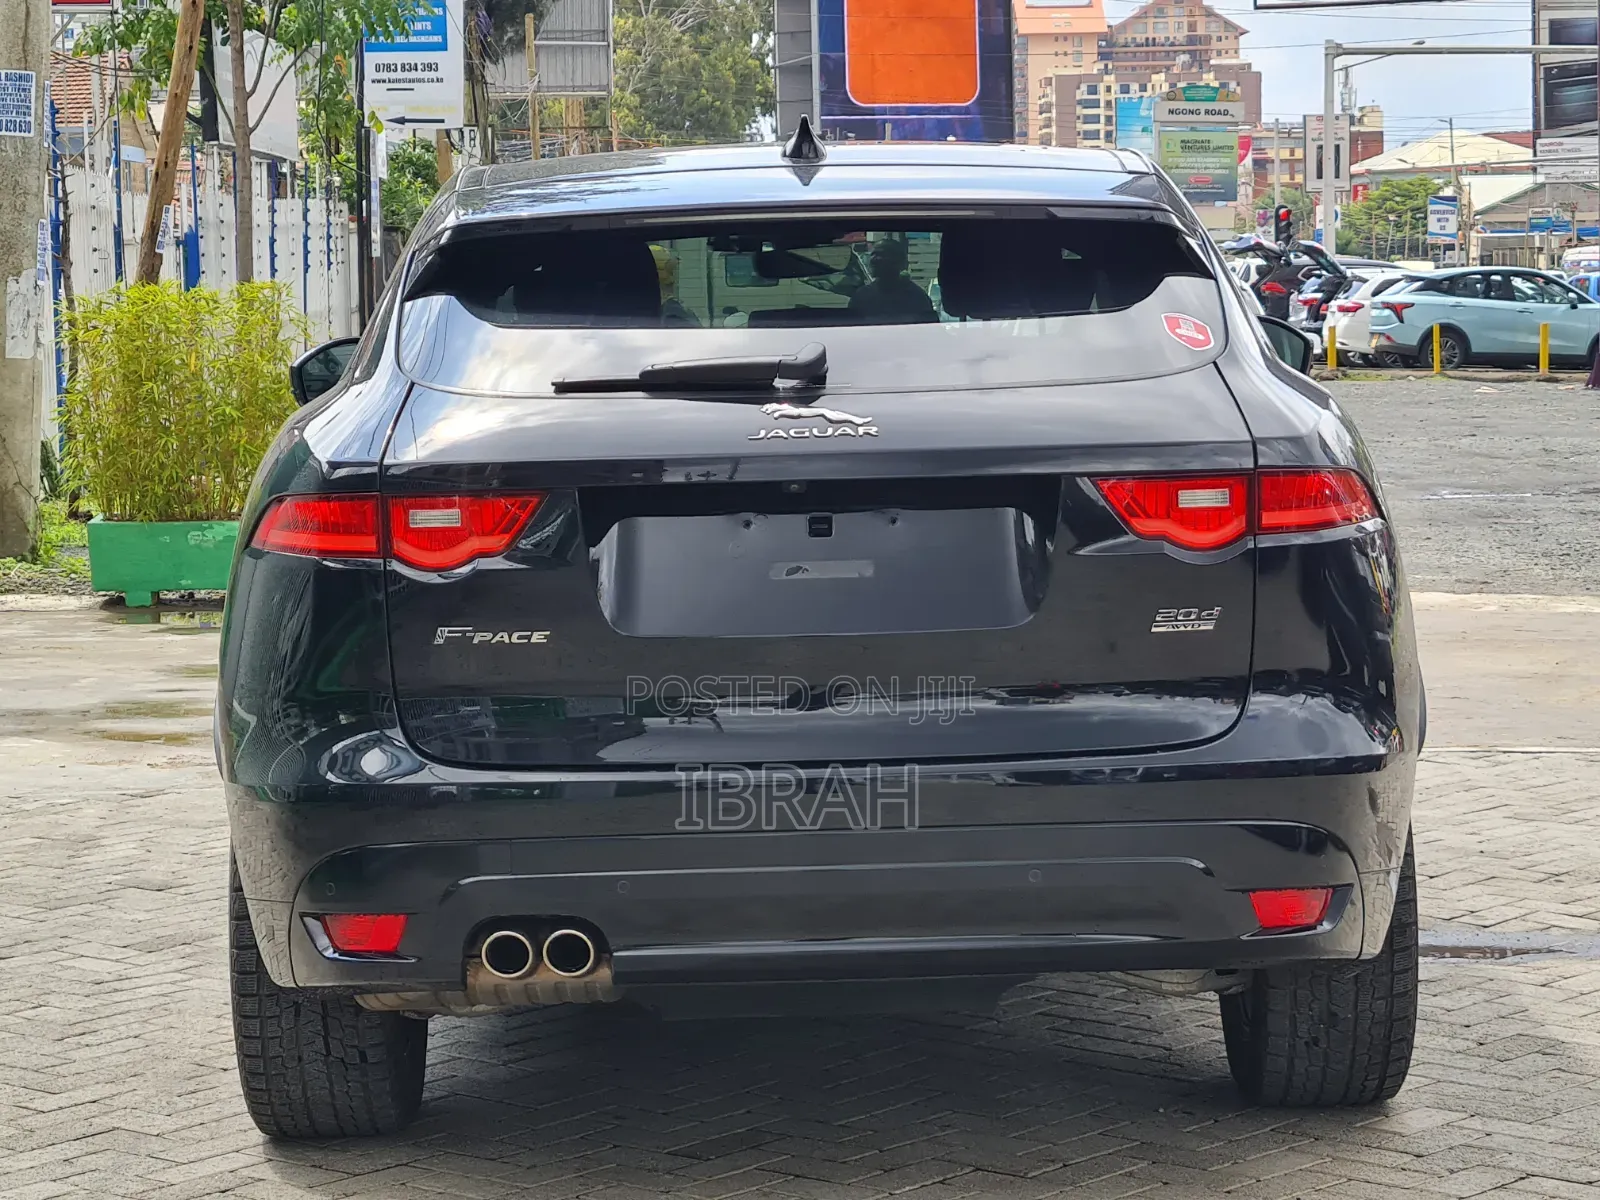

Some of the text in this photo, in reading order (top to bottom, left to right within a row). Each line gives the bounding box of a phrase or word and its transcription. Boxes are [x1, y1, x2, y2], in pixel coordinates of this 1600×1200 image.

[375, 62, 438, 73] 0783 834 393
[5, 72, 33, 83] RASHIDI
[1168, 108, 1229, 116] NGONG ROAD
[5, 119, 17, 133] 828
[19, 120, 31, 134] 630
[748, 426, 879, 440] JAGUAR
[1155, 607, 1222, 621] 20d
[433, 626, 551, 644] F-PACE
